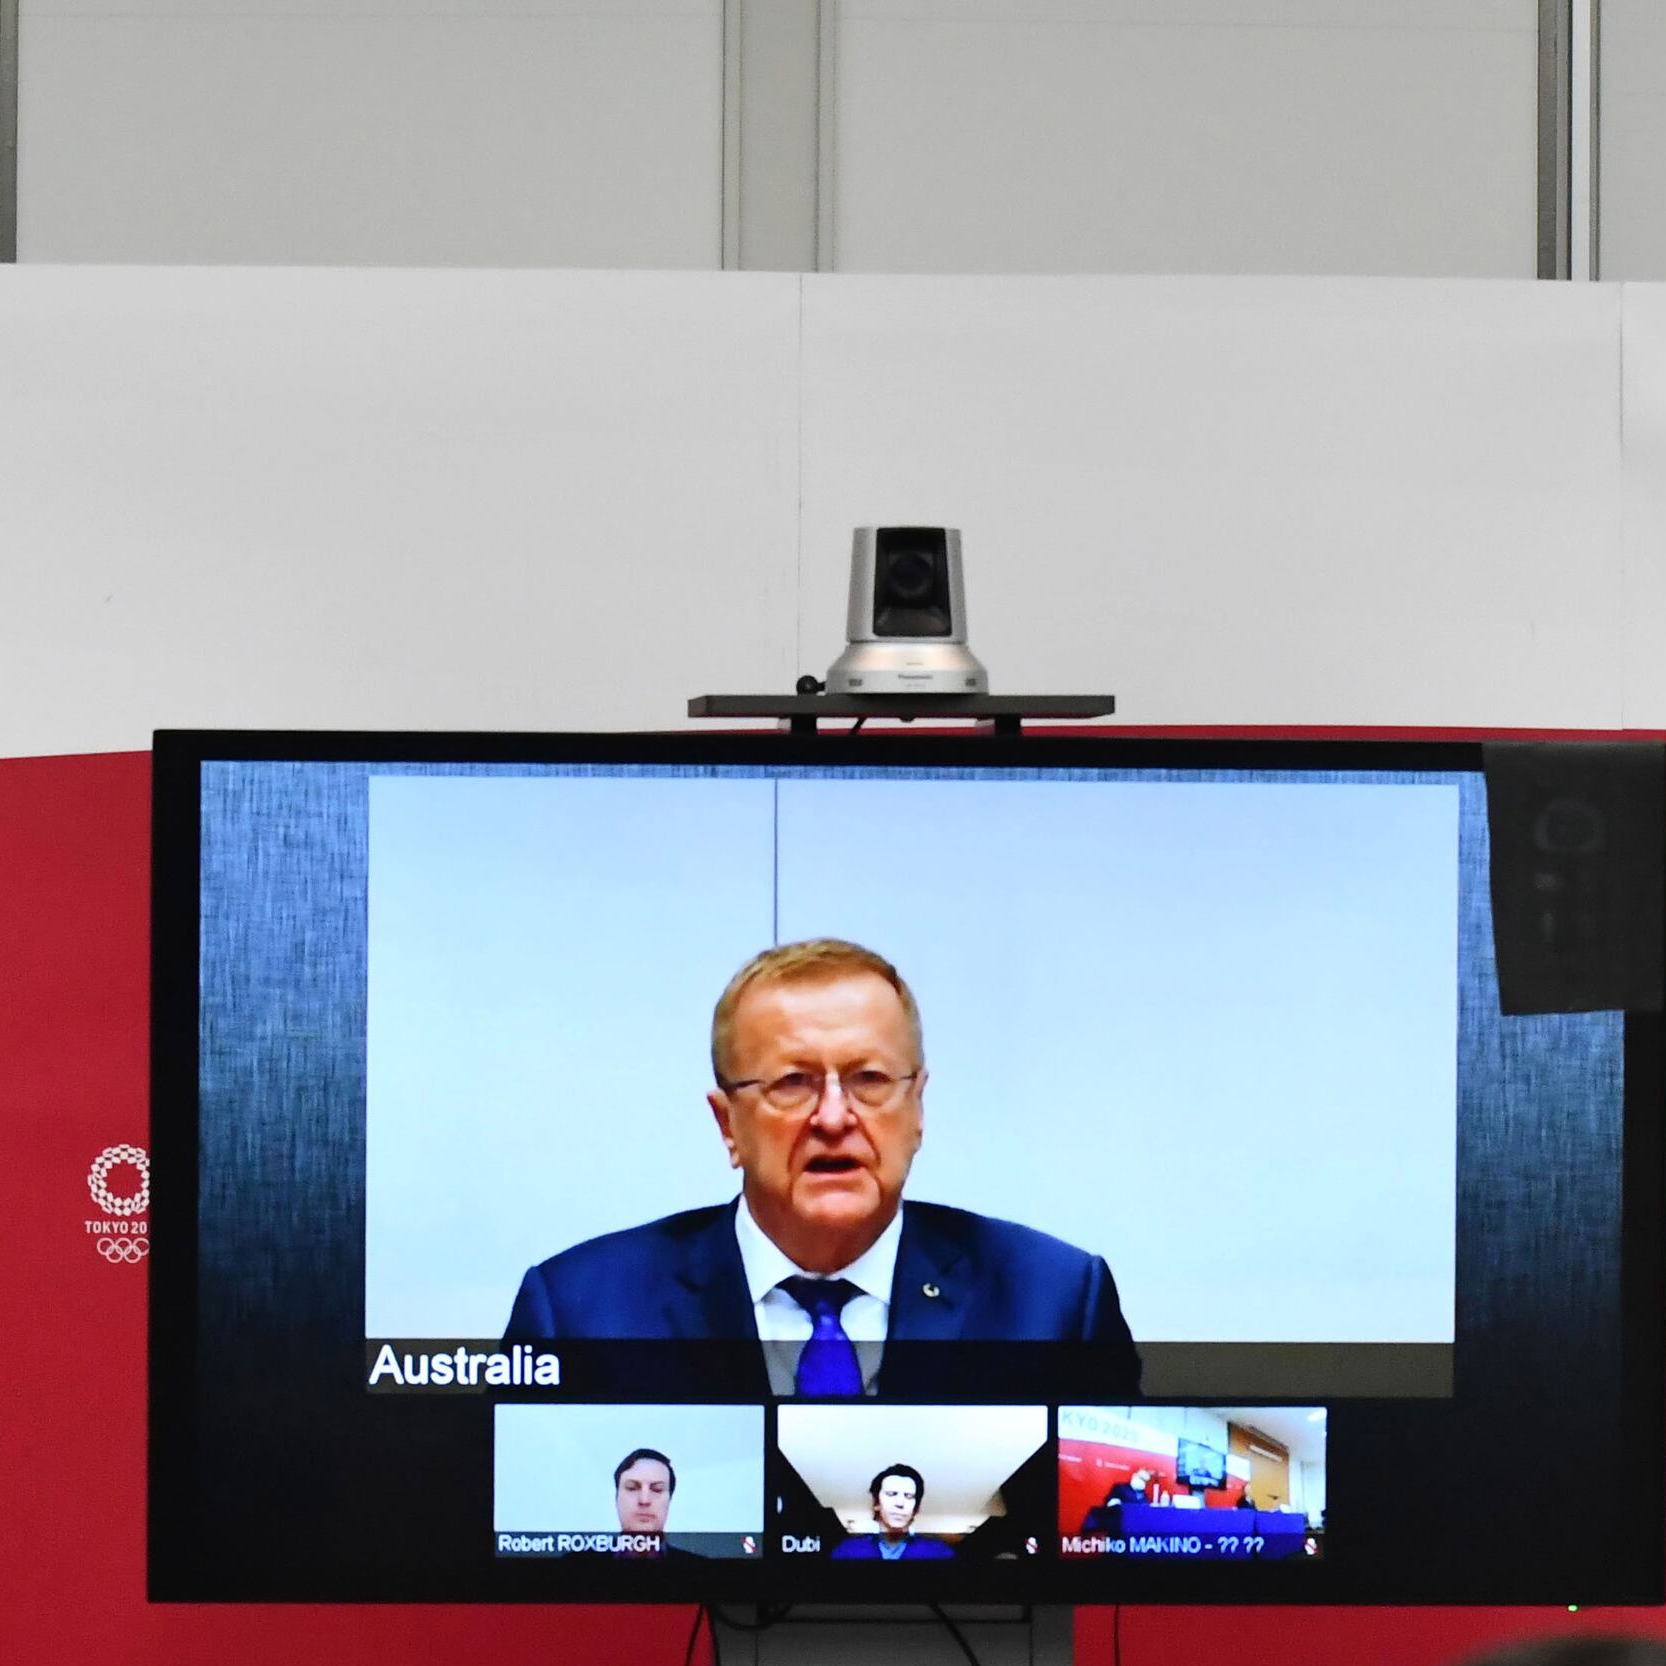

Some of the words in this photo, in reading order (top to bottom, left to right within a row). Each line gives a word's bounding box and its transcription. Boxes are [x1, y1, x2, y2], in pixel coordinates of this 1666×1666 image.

[85, 1220, 129, 1234] TOKYO
[368, 1343, 561, 1386] Australia
[497, 1533, 555, 1553] Robert
[557, 1534, 661, 1553] ROXBURGH
[782, 1535, 822, 1553] Dubi
[1061, 1535, 1127, 1554] Michiko
[1129, 1536, 1202, 1554] MAKINO
[1218, 1537, 1239, 1554] ??
[1243, 1537, 1265, 1554] ??
